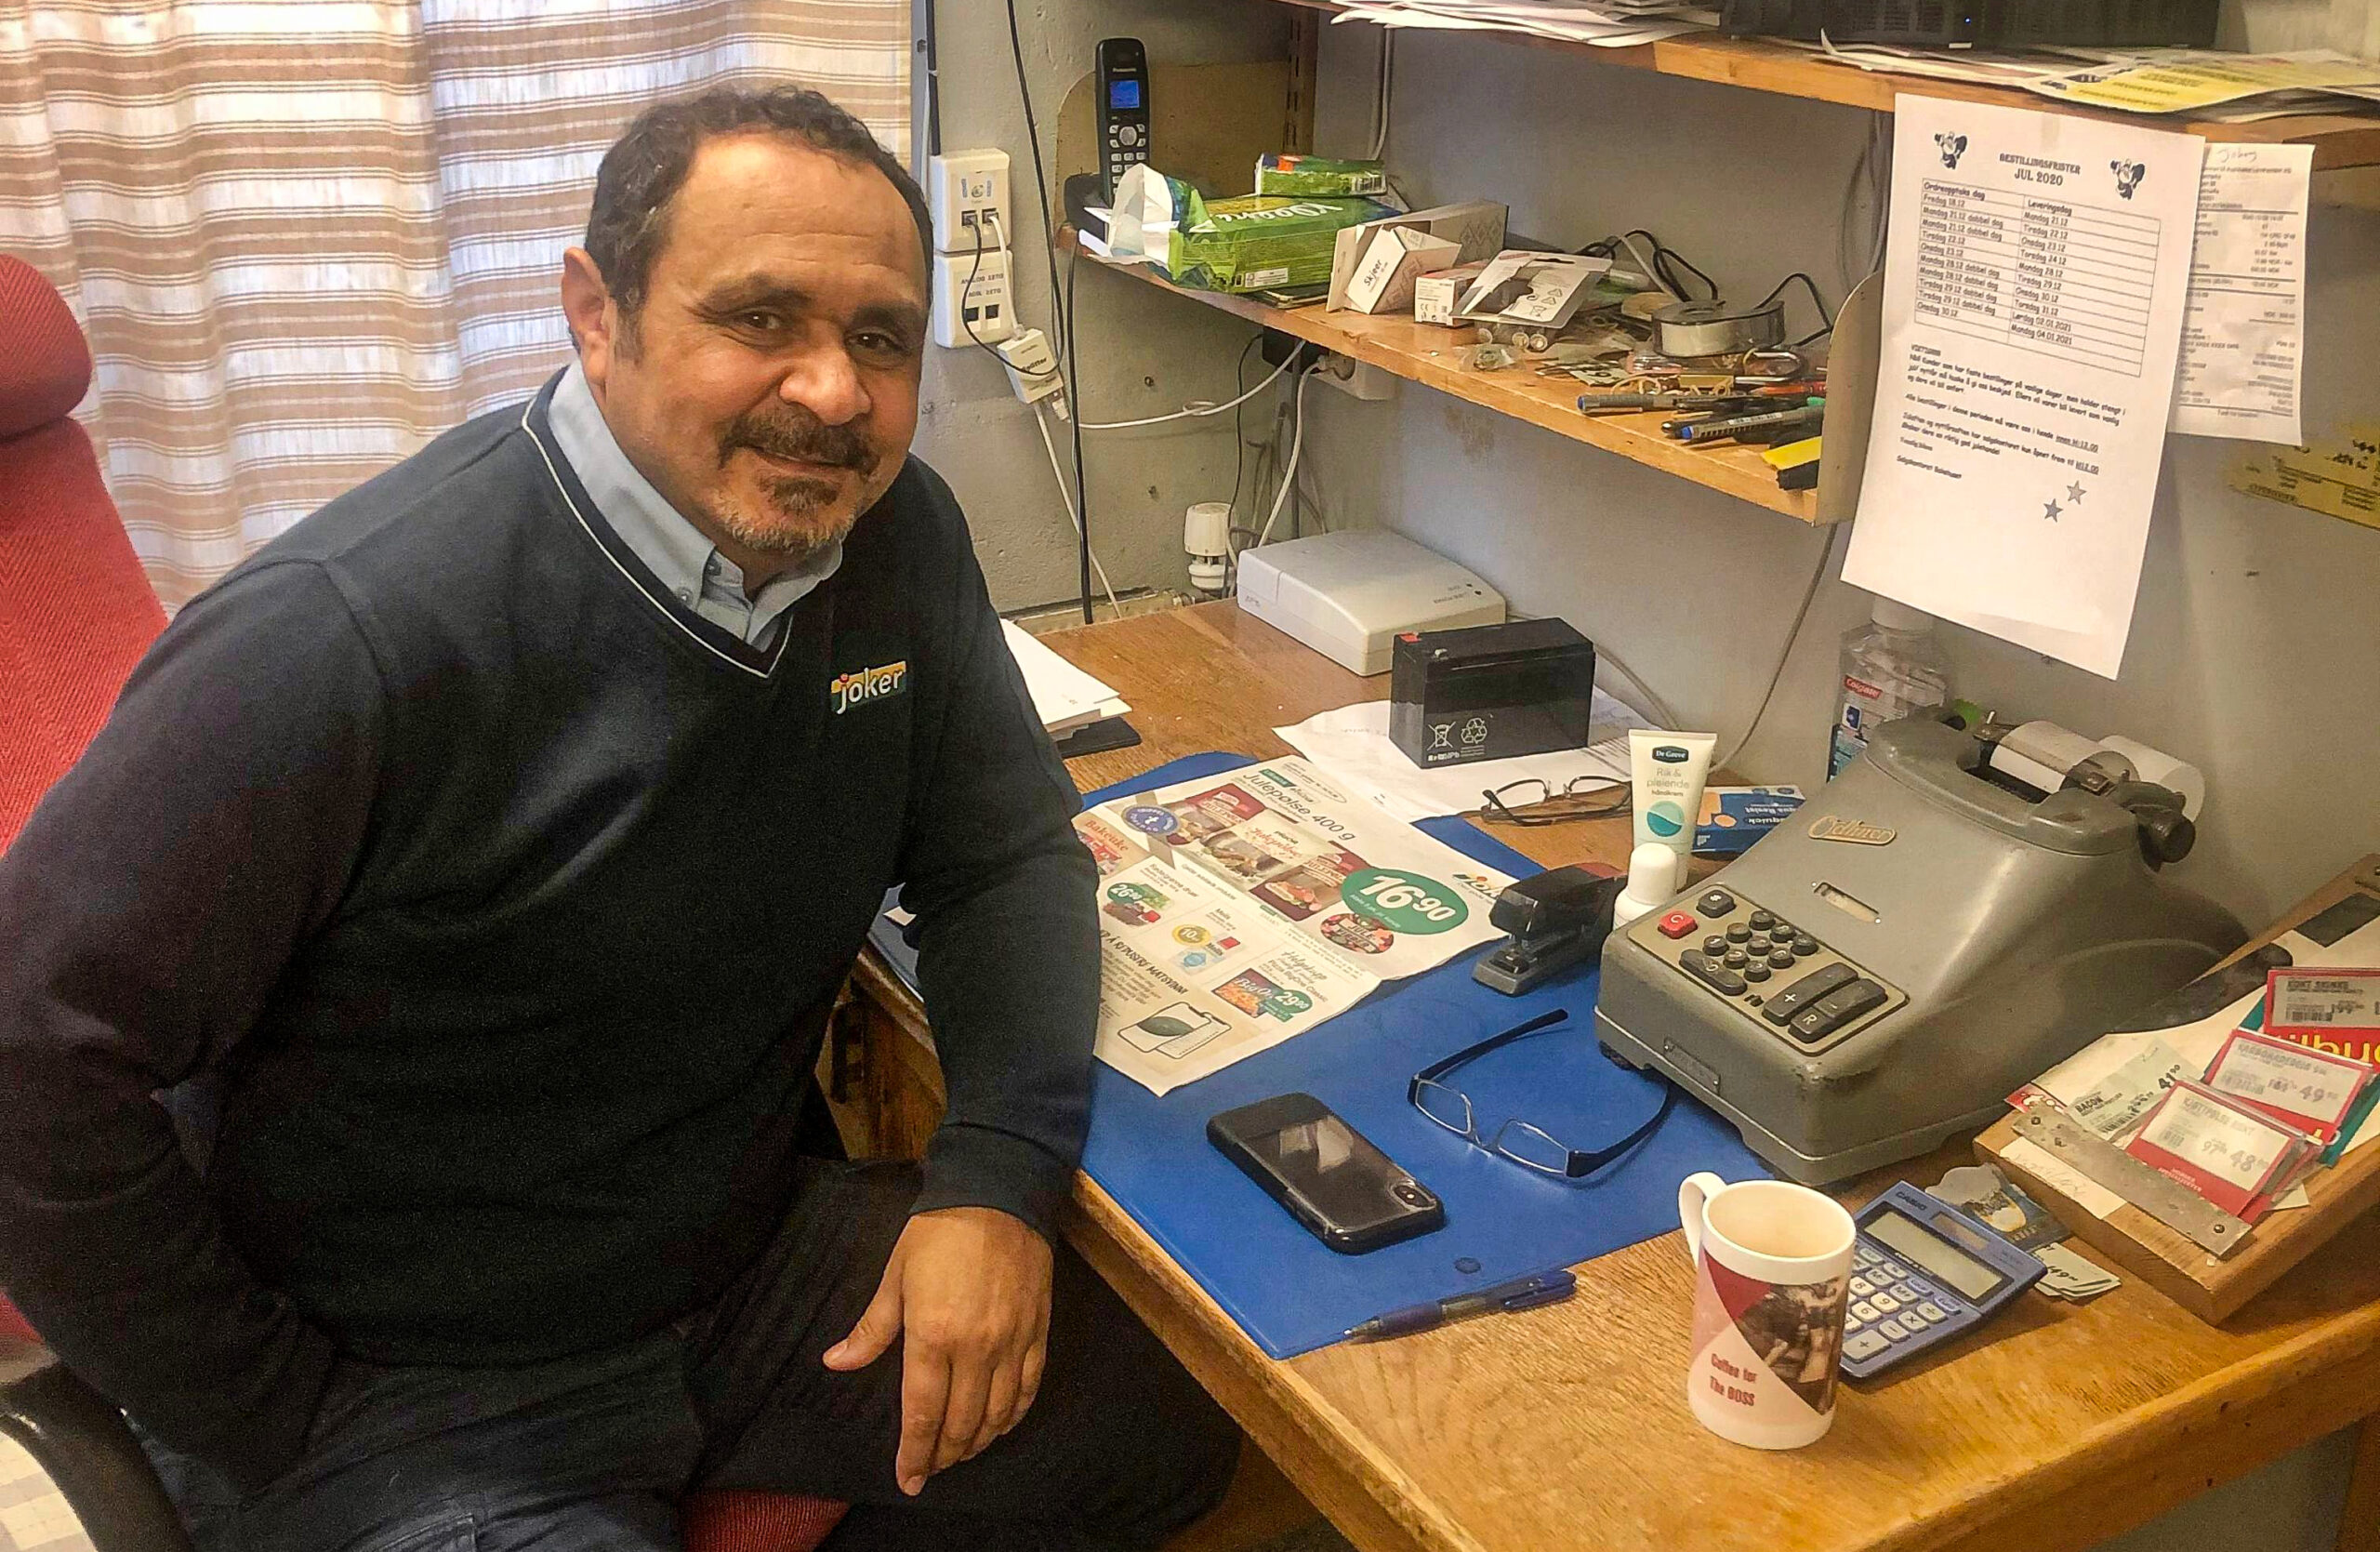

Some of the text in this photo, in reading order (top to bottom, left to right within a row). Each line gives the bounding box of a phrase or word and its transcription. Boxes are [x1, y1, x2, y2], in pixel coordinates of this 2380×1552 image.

[2014, 168, 2063, 186] JUL 2020
[1924, 193, 1947, 206] Fredag
[1972, 190, 1985, 201] dag
[2028, 199, 2072, 216] Leveringsdag
[1924, 206, 1948, 219] Mandag
[1992, 219, 2003, 230] dag
[2024, 211, 2049, 224] Mandag
[1923, 219, 1947, 232] Mandag
[1990, 232, 2002, 242] dag
[1923, 231, 1946, 245] Tirsdag
[2024, 224, 2049, 238] Tirsdag
[1921, 243, 1944, 256] Onsdag
[2021, 237, 2045, 250] Onsdag
[2020, 249, 2046, 263] Torsdag
[1363, 259, 1382, 285] Skjeer
[1920, 255, 1944, 268] Mandag
[1988, 268, 2000, 279] dag
[2018, 262, 2043, 276] Mandag
[1920, 267, 1943, 279] Mandag
[1987, 281, 1998, 291] dag
[2017, 274, 2042, 288] Tirsdag
[1919, 278, 1943, 291] Tirsdag
[1986, 292, 1997, 304] dag
[2016, 286, 2039, 300] Onsdag
[1917, 301, 1939, 314] Onsdag
[1918, 289, 1942, 304] Tirsdag
[1984, 304, 1996, 316] dag
[2015, 298, 2040, 314] Torsdag
[2011, 324, 2035, 338] Mandag
[837, 668, 903, 714] joker
[1243, 774, 1312, 816] Julepølse
[1312, 816, 1344, 834] 400
[1339, 831, 1355, 841] g
[1085, 818, 1129, 852] Bakeuke
[1803, 1014, 1818, 1025] R
[2075, 1095, 2104, 1113] BACON
[1896, 1190, 1927, 1211] CASIO
[1712, 1353, 1757, 1383] Coffee for
[1710, 1375, 1755, 1406] The BOSS
